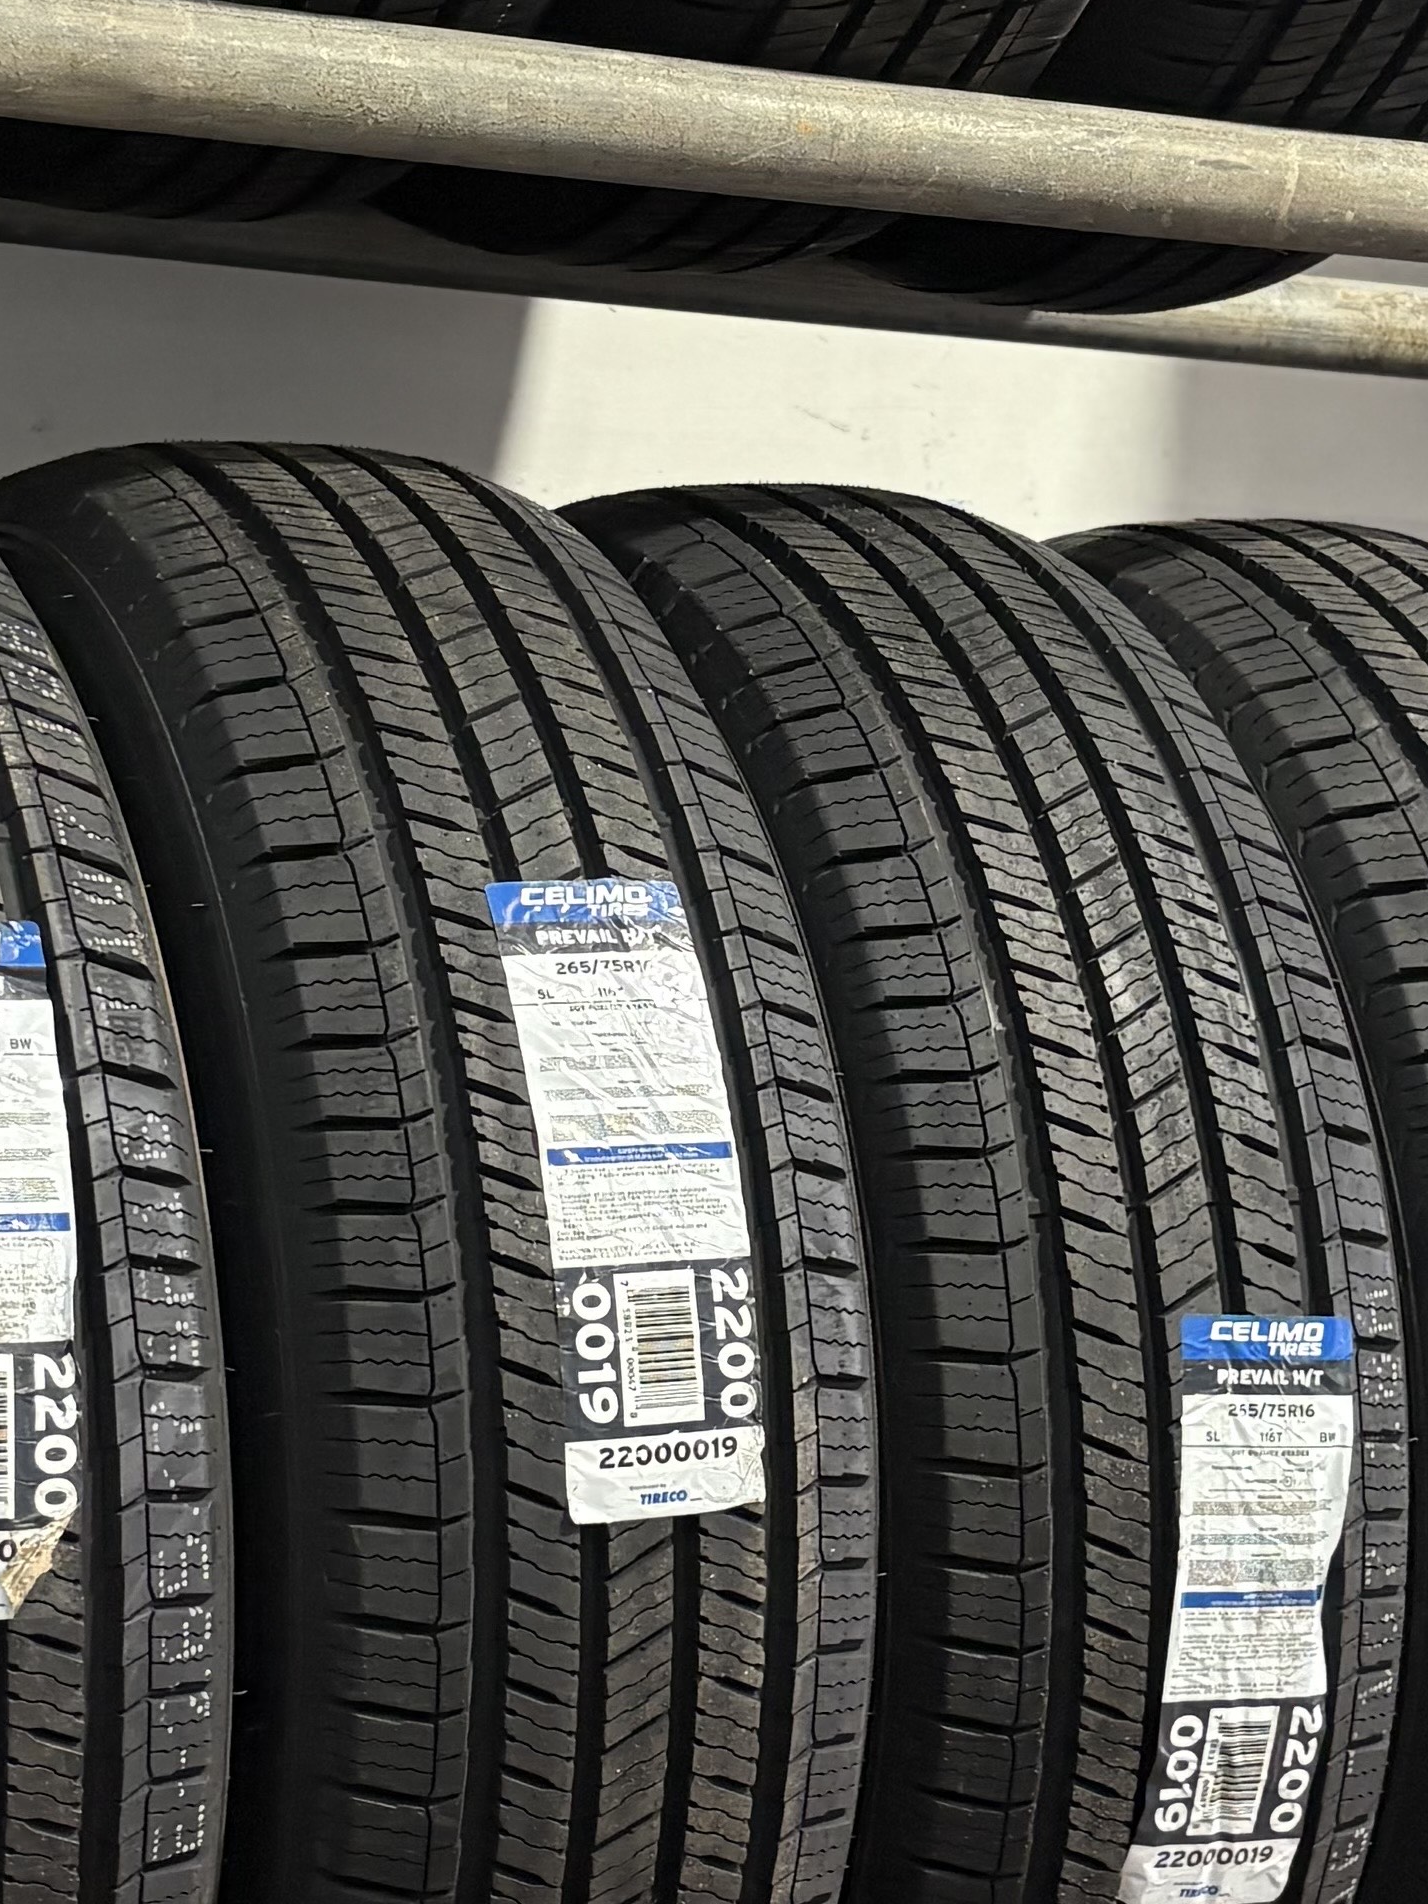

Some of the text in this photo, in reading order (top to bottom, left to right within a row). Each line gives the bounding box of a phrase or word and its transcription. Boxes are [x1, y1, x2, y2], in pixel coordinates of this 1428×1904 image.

[521, 885, 652, 906] CELIMO
[536, 929, 617, 946] PREVAIL
[10, 1039, 32, 1050] BW
[710, 1267, 757, 1418] 2200
[1211, 1321, 1324, 1343] CELIMO
[572, 1282, 619, 1424] 0019
[1268, 1342, 1323, 1356] TIRES
[1217, 1368, 1324, 1387] PREVAIL H/T
[1228, 1402, 1315, 1419] 265/75R16
[33, 1353, 79, 1518] 2200
[599, 1436, 738, 1470] 22000019
[640, 1489, 689, 1505] TIRECO
[1154, 1715, 1204, 1832] 0019
[1270, 1704, 1323, 1832] 2200
[1154, 1846, 1273, 1869] 22000019
